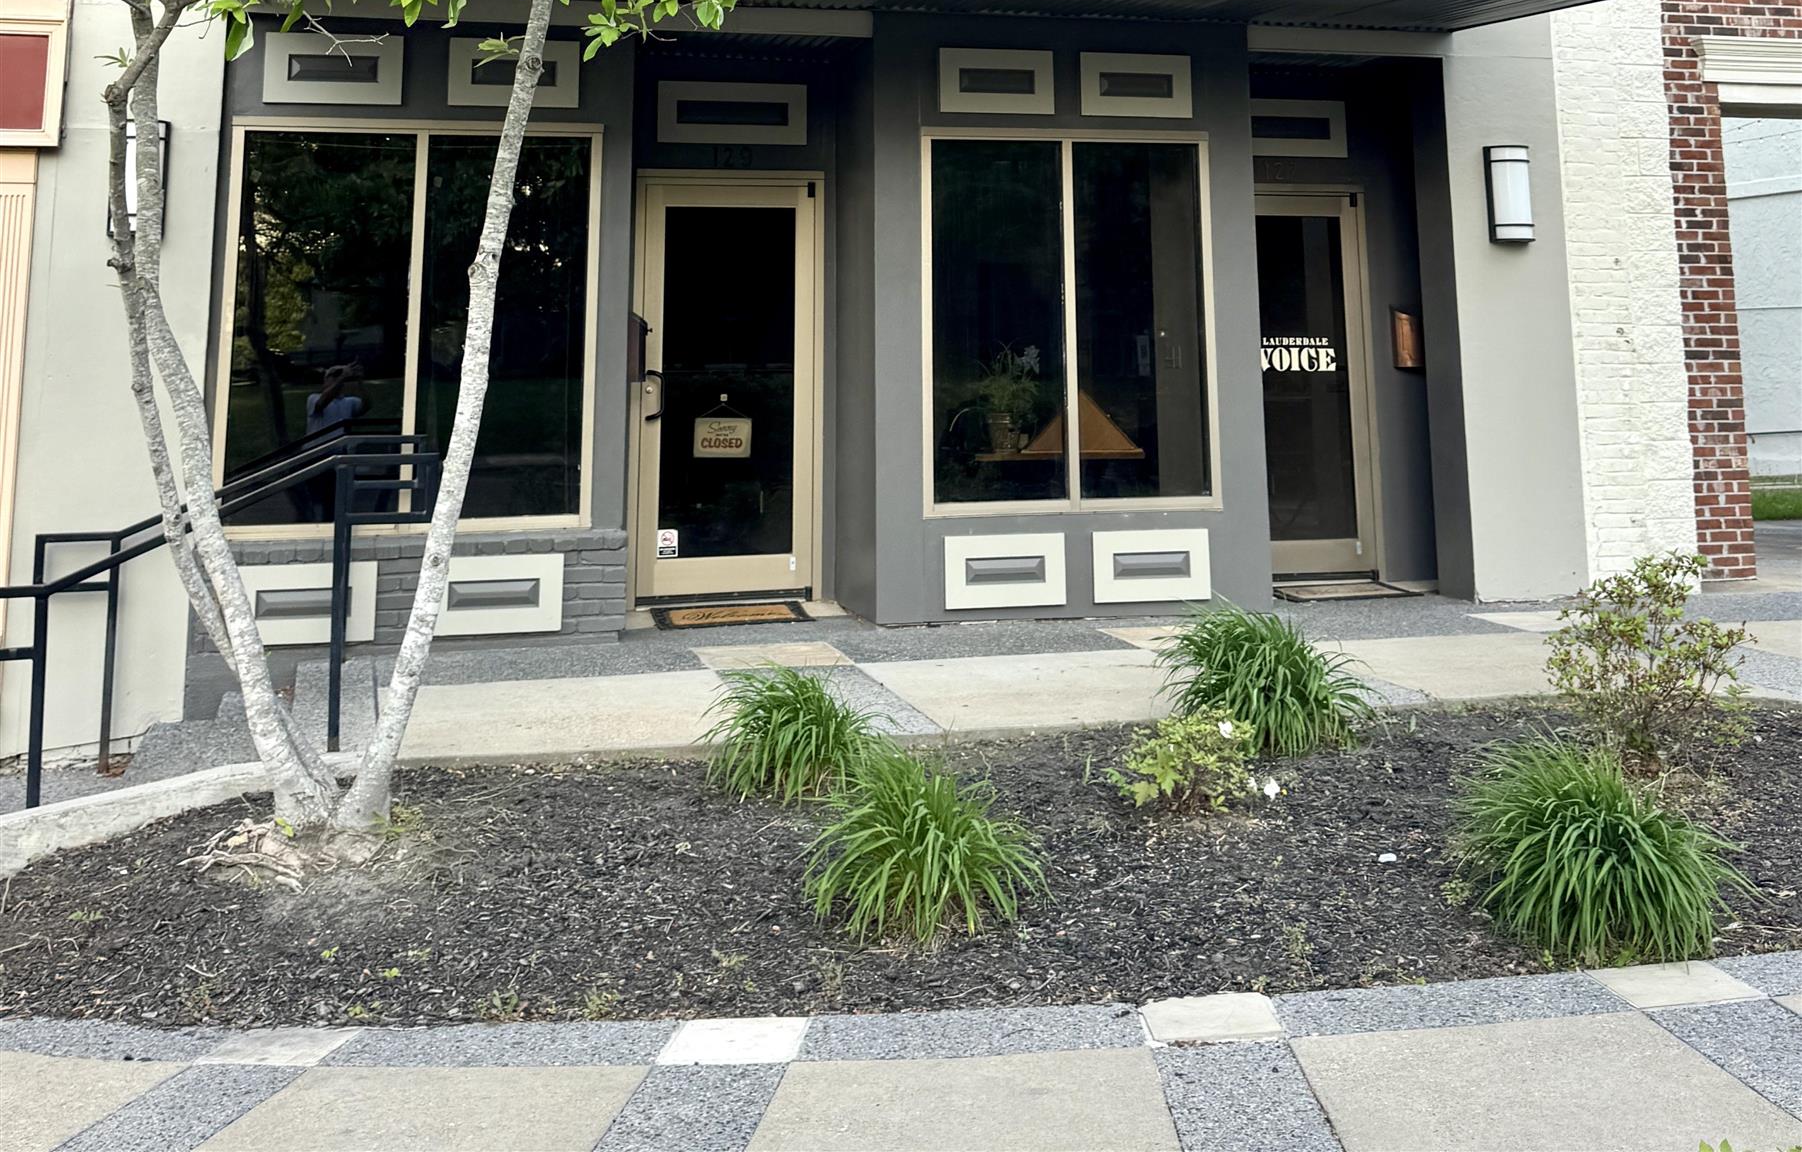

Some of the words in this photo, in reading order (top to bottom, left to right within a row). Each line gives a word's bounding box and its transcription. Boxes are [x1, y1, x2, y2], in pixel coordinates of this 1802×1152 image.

[712, 146, 752, 167] 129
[1262, 337, 1329, 346] LAUDERDALE
[1260, 347, 1337, 372] VOICE
[700, 437, 743, 449] CLOSED
